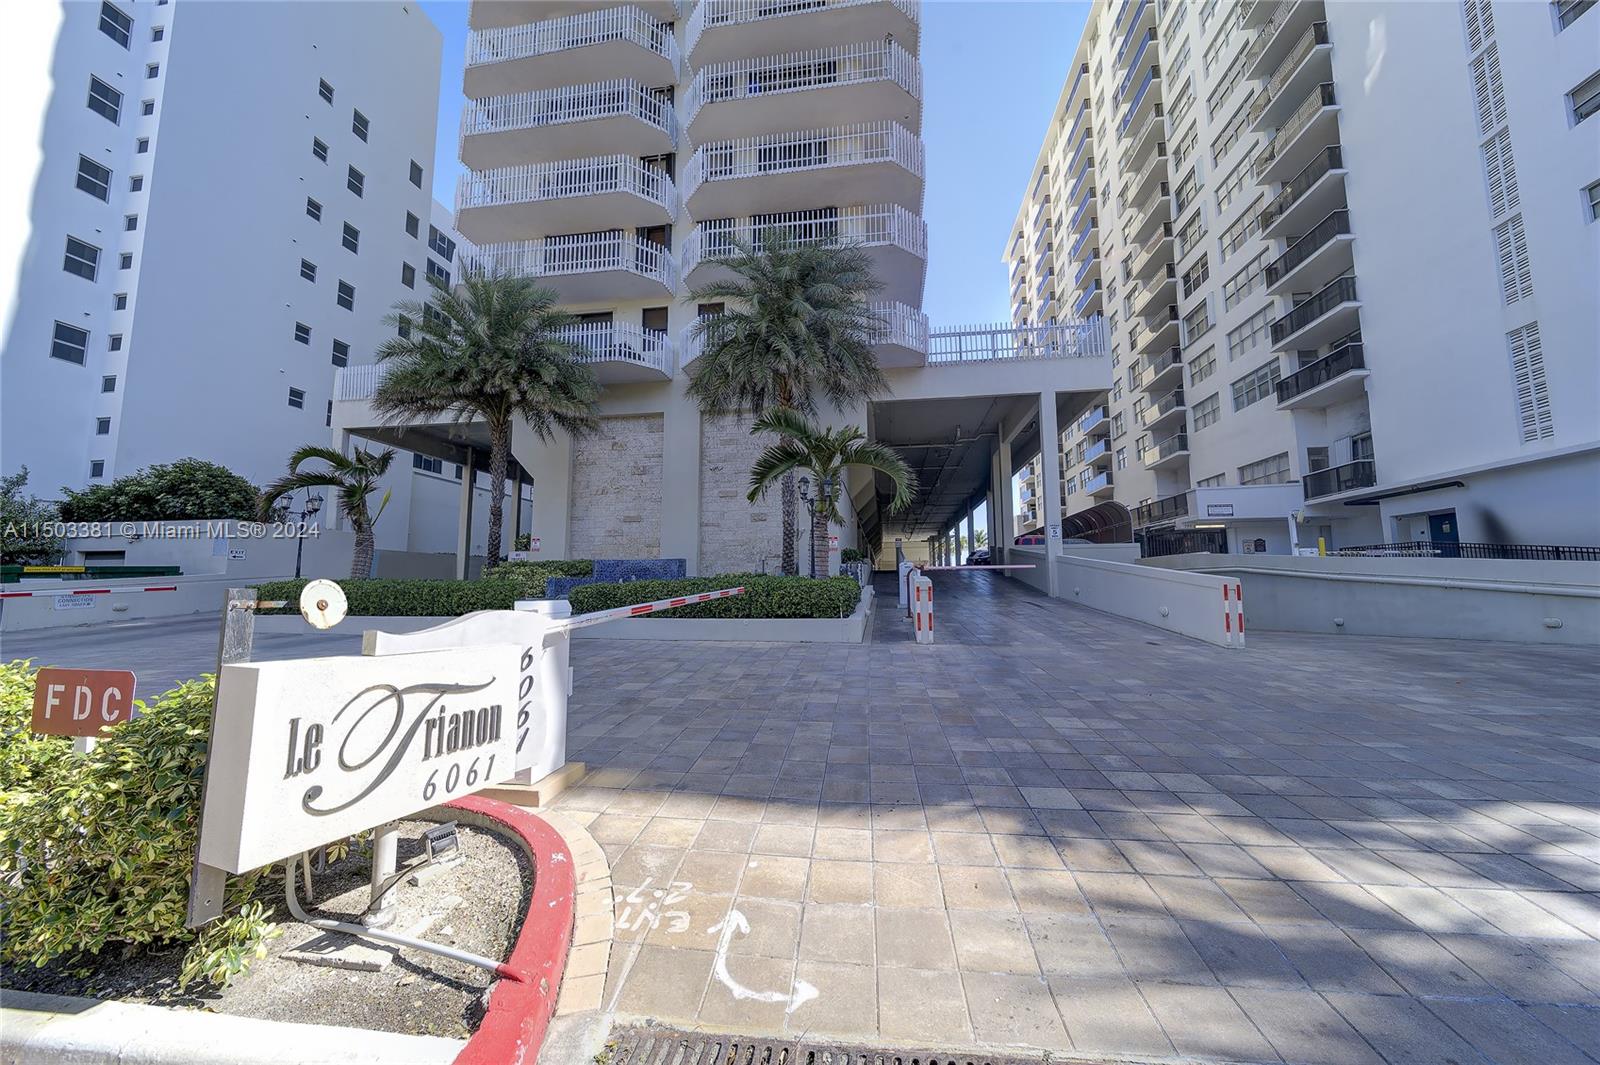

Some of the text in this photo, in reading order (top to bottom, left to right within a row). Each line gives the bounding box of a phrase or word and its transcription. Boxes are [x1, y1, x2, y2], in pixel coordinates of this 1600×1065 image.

[283, 677, 502, 817] Le Trianon
[517, 646, 534, 754] 6061
[422, 753, 496, 801] 6061
